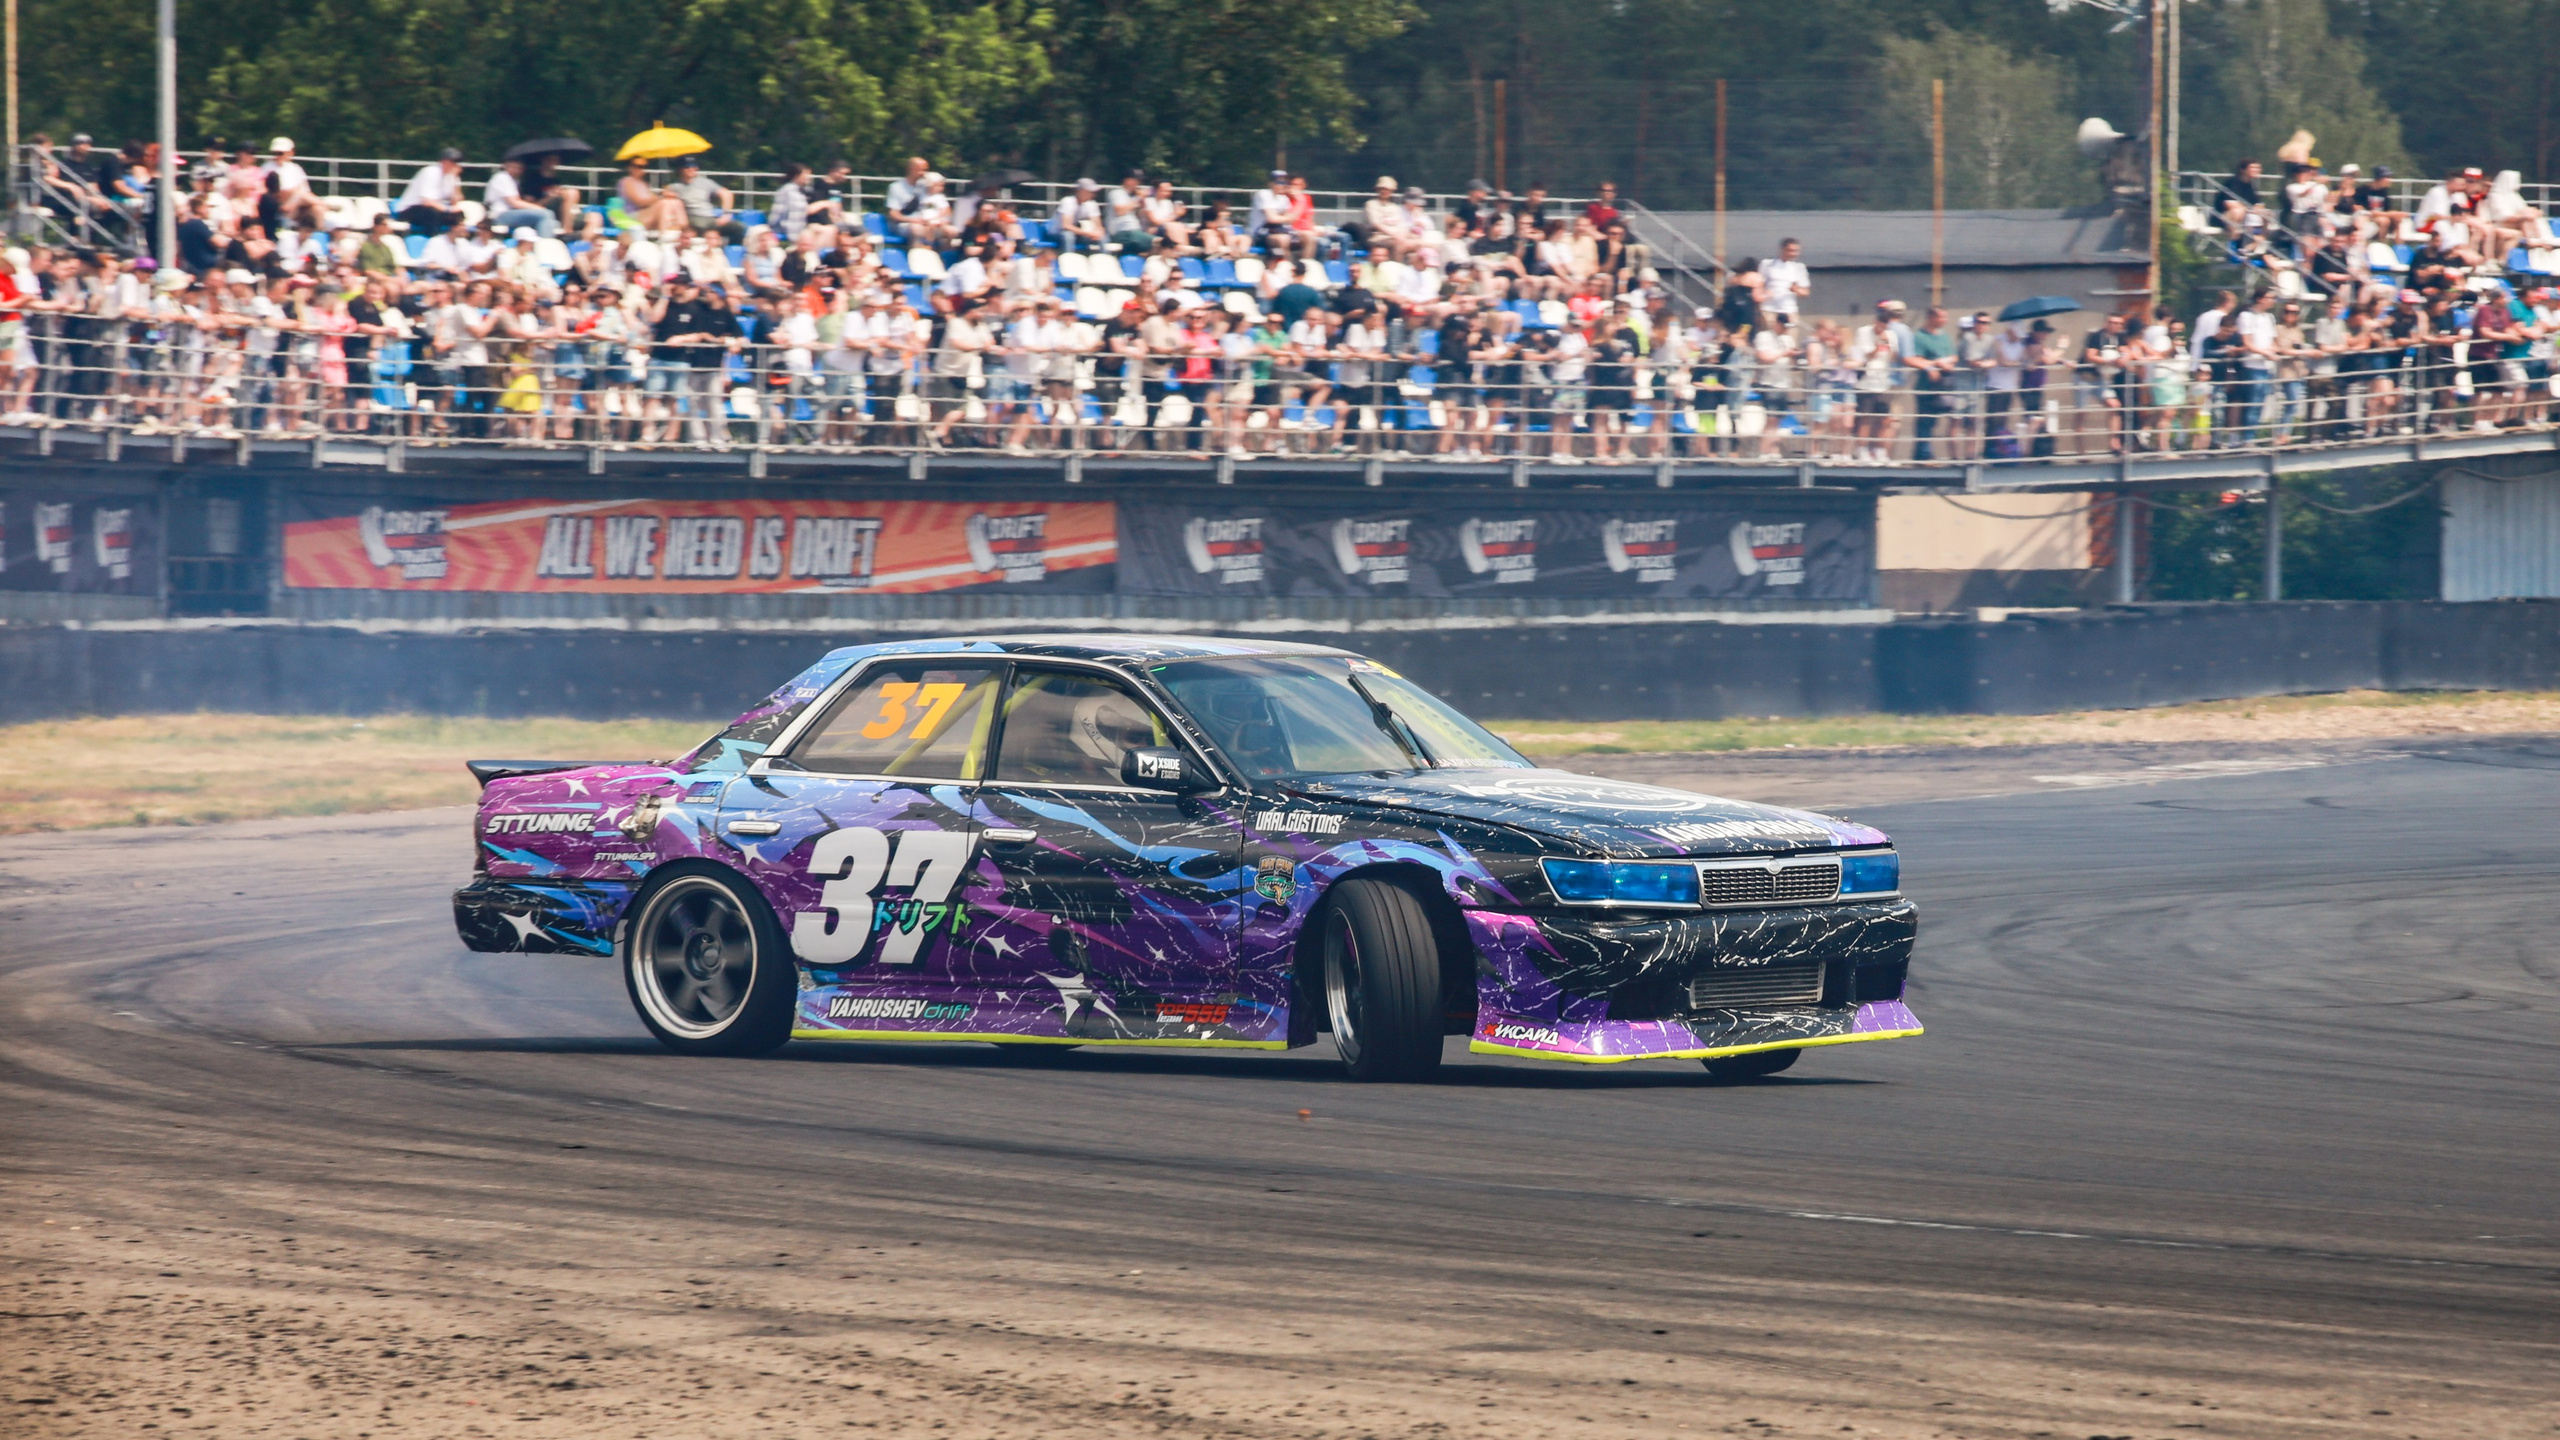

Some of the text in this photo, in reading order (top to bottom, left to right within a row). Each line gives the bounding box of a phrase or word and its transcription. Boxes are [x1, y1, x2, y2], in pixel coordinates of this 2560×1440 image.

[1205, 518, 1264, 542] DRIFT
[1354, 519, 1411, 543] DRIFT
[1481, 519, 1537, 543] DRIFT
[1623, 519, 1678, 543] DRIFT
[1751, 523, 1805, 546] DRIFT
[537, 515, 882, 580] ALL WE NEED IS DRIFT
[861, 682, 966, 740] 37
[1157, 757, 1181, 771] XSIDE
[790, 826, 981, 964] 37
[872, 901, 972, 935] ドリフト
